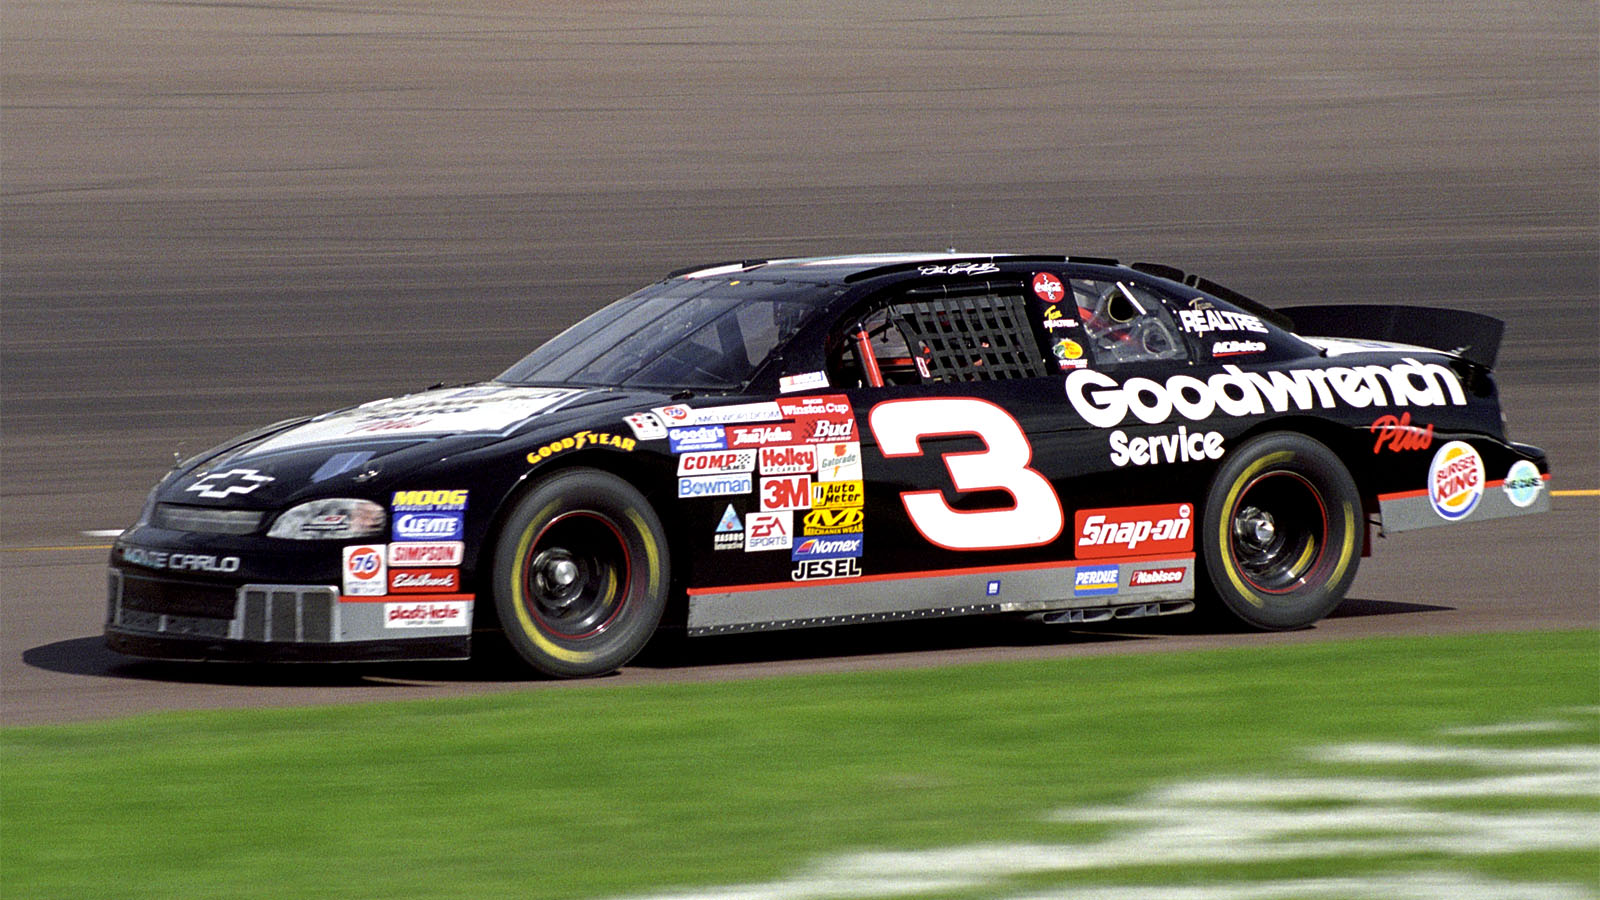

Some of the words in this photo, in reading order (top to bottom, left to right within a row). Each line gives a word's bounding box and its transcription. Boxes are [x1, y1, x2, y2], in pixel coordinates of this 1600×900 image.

[1179, 310, 1269, 333] REALTREE
[1066, 357, 1468, 428] Goodwrench
[782, 404, 826, 415] Winston
[826, 402, 849, 414] Cup
[814, 420, 853, 438] Bud
[1371, 412, 1434, 454] Plus
[526, 431, 636, 464] GOODYEAR
[1109, 425, 1225, 467] Service
[683, 454, 737, 470] COMP
[762, 447, 814, 471] Holley
[822, 454, 856, 468] Gatorade
[720, 464, 746, 472] CAMS
[868, 396, 1065, 551] 3
[1436, 455, 1477, 482] BURGER
[680, 479, 751, 495] Bowman
[763, 478, 809, 509] 3M
[826, 484, 855, 493] Auto
[1437, 468, 1478, 503] KING
[392, 490, 469, 506] MOOG
[825, 494, 861, 506] Meter
[1078, 514, 1191, 549] Snap-on
[749, 536, 788, 547] SPORTS
[811, 539, 858, 554] Nomex
[394, 546, 456, 561] SIMPSON
[169, 554, 240, 572] CARLO
[353, 555, 375, 571] 76
[794, 560, 860, 580] JESEL
[1075, 569, 1119, 585] PERDUE
[1137, 570, 1182, 584] Nabisco
